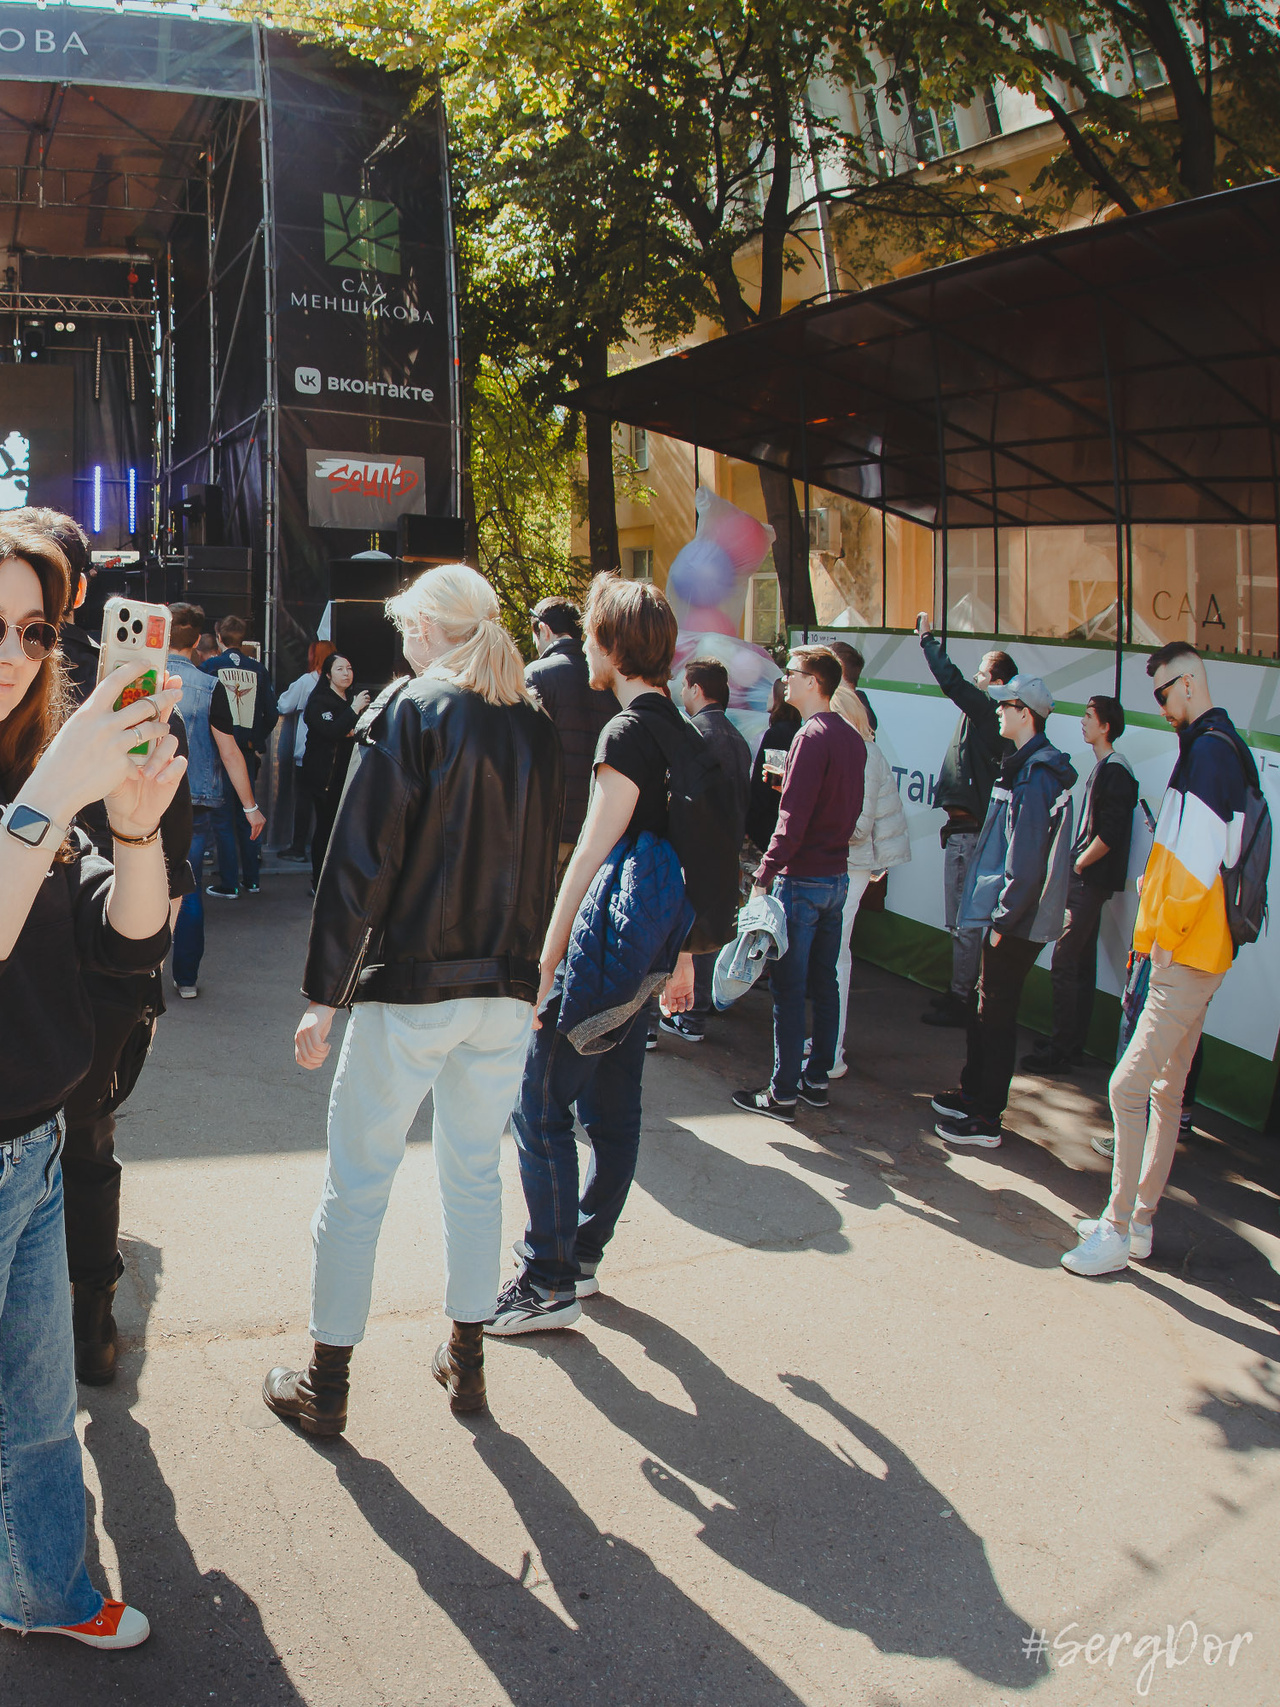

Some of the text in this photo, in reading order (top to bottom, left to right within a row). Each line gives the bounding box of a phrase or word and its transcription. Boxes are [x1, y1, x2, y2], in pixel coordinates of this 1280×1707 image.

[341, 278, 387, 299] САД
[290, 291, 434, 325] МЕНШИКОВА
[327, 457, 419, 505] SOUND
[1152, 590, 1226, 629] САД
[222, 669, 255, 684] NIRVANA
